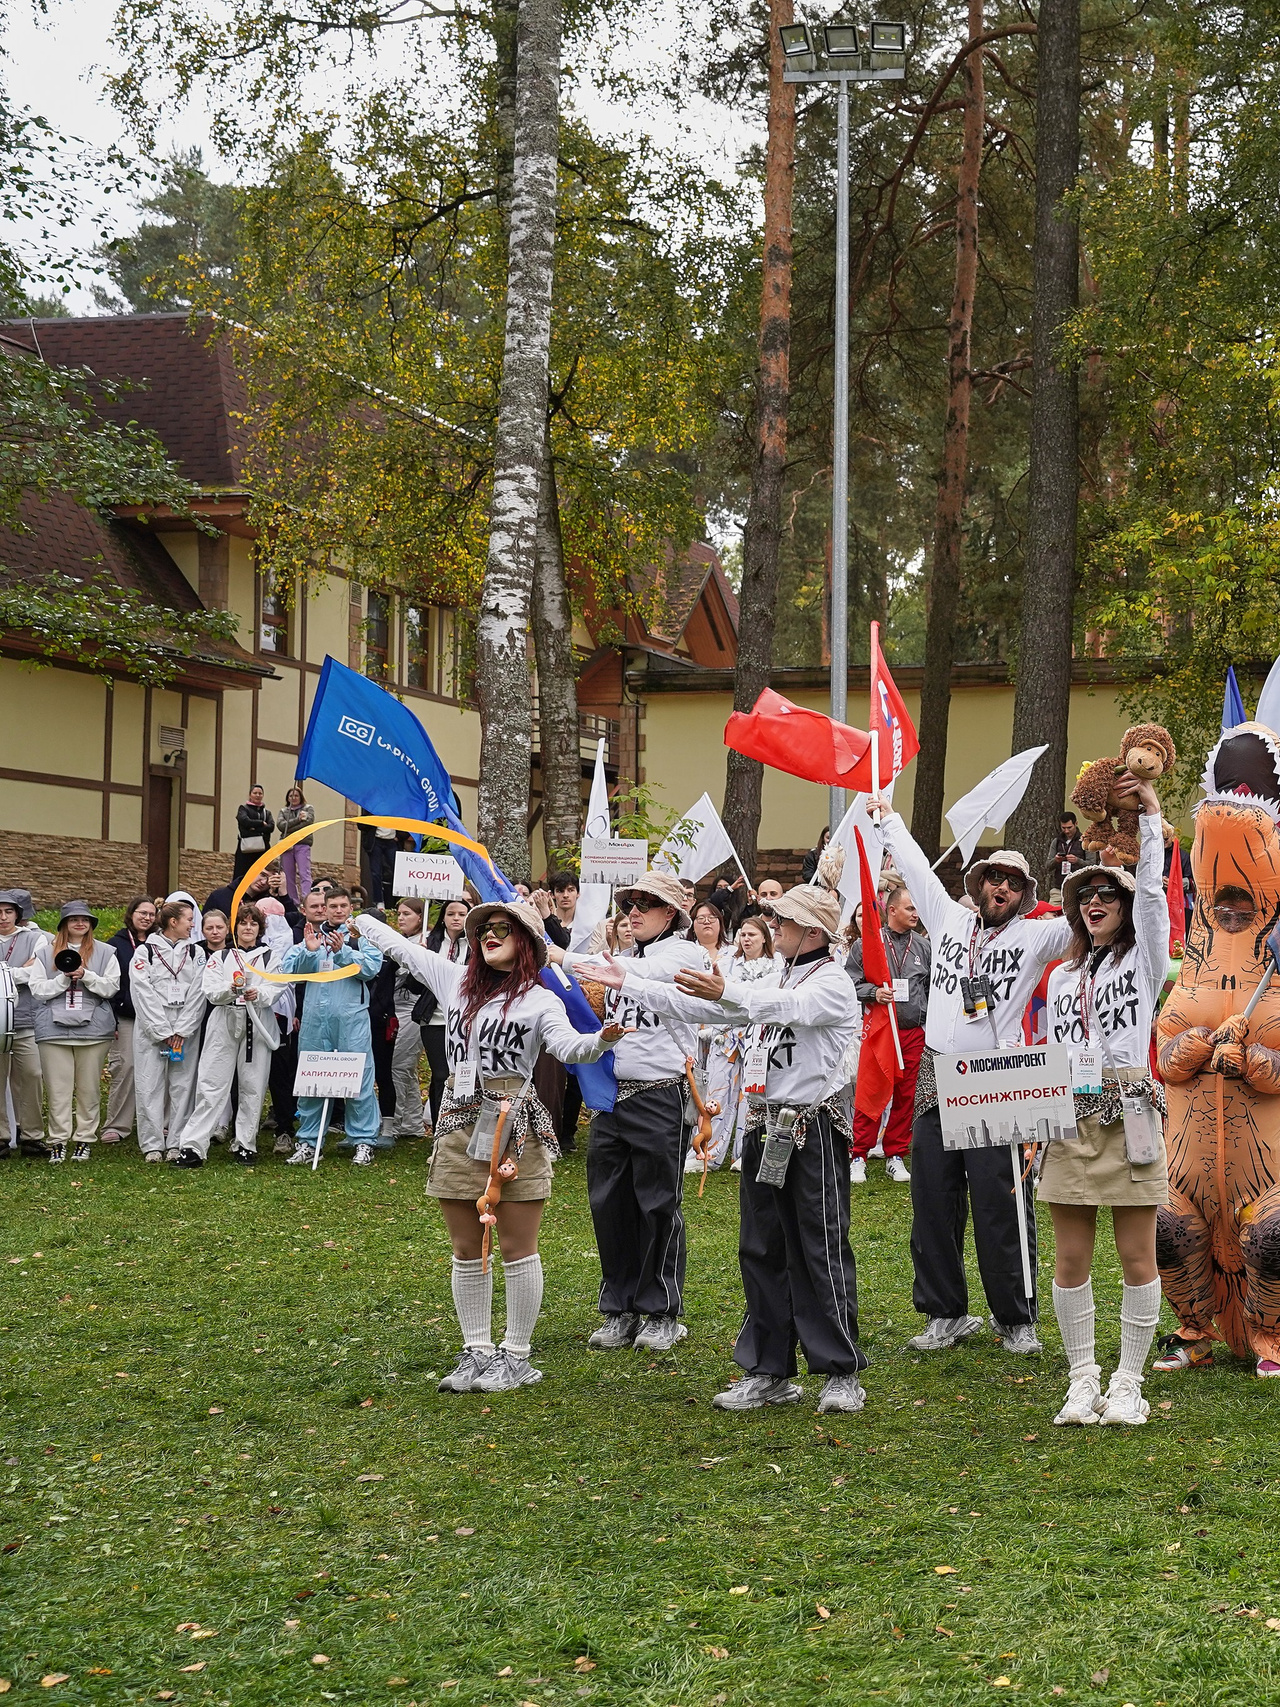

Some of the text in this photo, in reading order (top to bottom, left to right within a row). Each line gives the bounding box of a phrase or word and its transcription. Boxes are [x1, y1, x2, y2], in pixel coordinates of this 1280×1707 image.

[345, 722, 369, 739] CG
[406, 856, 455, 865] КОЛДИ
[408, 870, 450, 881] КОЛДИ
[932, 962, 1017, 1002] ПРО КТ
[1098, 998, 1139, 1037] ЕКТ
[479, 1018, 532, 1050] ИНЖ
[300, 1070, 338, 1078] КАПИТАЛ
[969, 1052, 1047, 1074] МОСИНЖПРОЕКТ
[946, 1085, 1068, 1108] МОСИНЖПРОЕКТ
